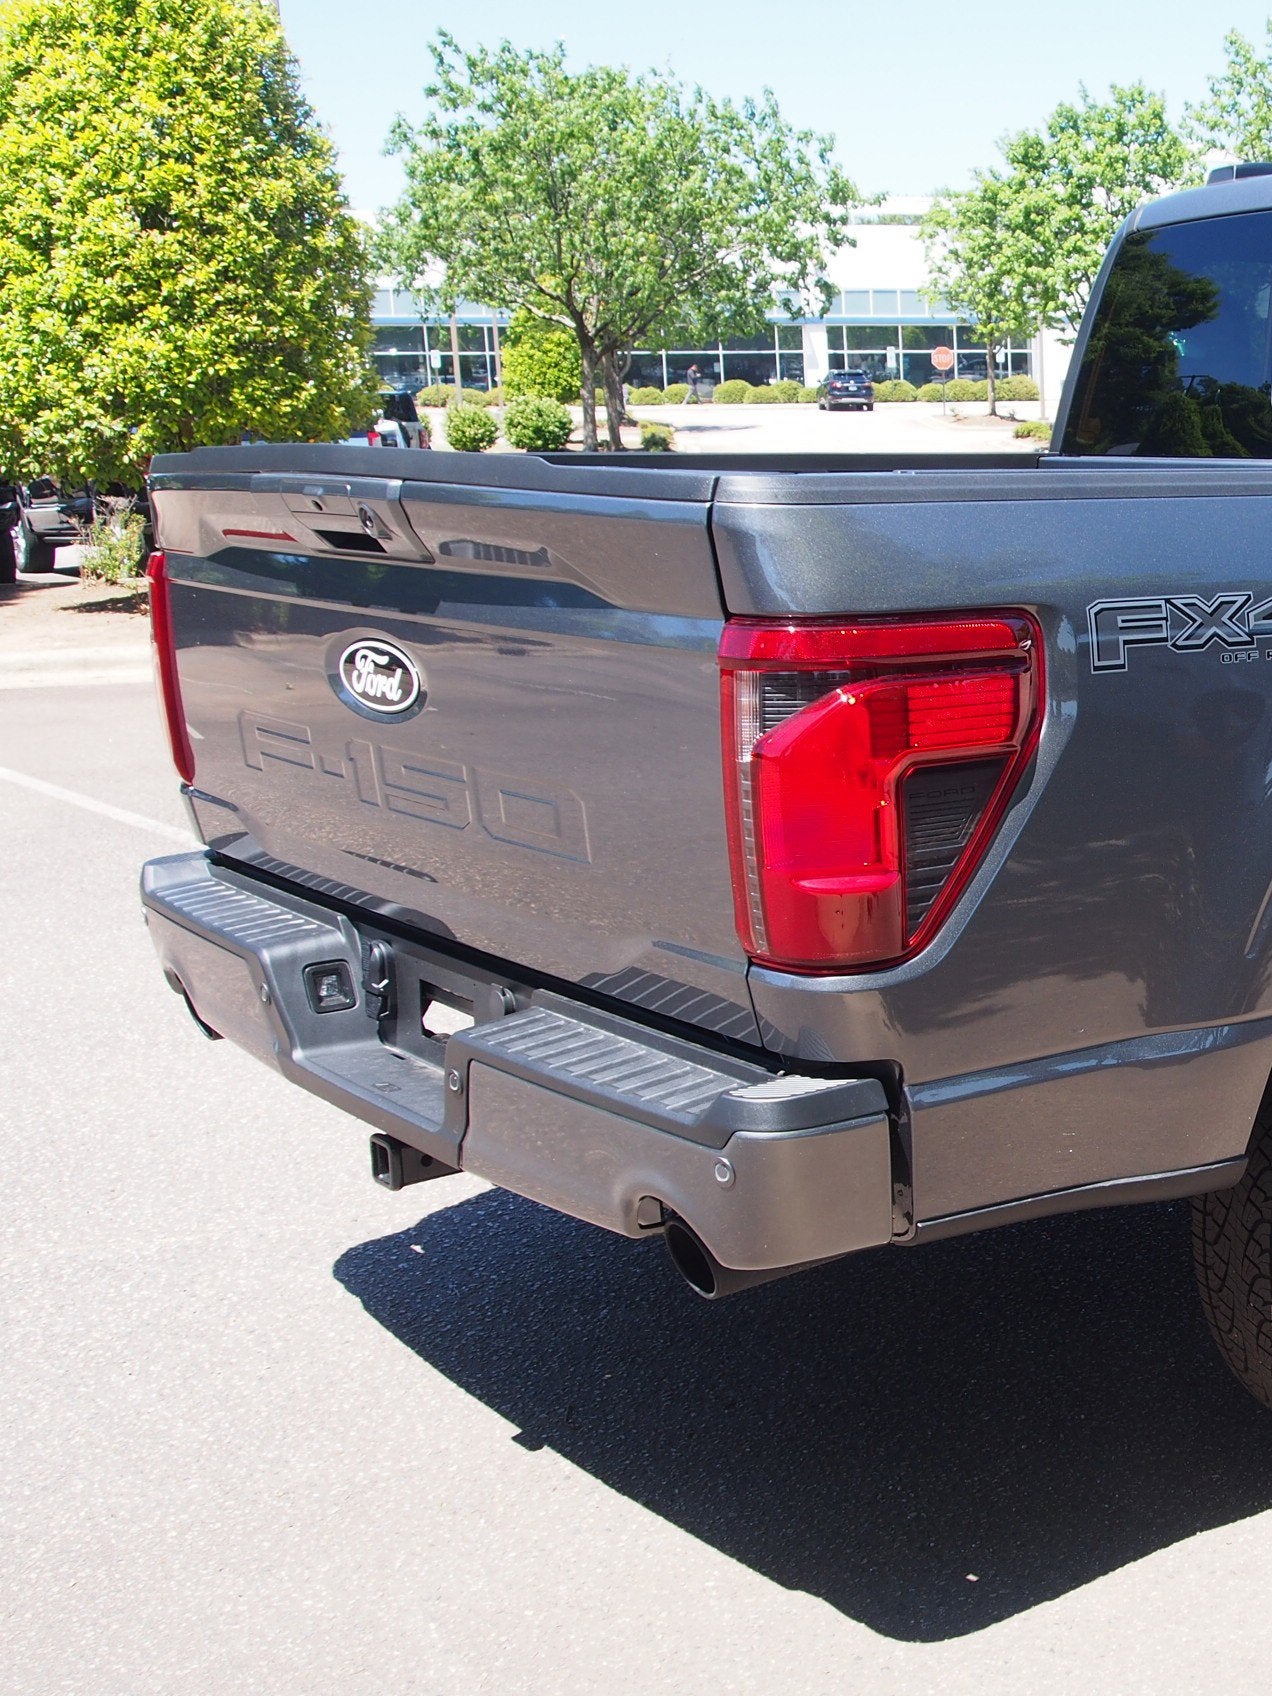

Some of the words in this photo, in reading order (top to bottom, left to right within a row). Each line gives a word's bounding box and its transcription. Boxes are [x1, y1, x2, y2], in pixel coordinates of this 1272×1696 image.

[933, 353, 952, 363] STOP
[1221, 651, 1260, 664] OFF
[351, 647, 404, 702] Ford
[237, 709, 593, 865] F-150
[908, 786, 976, 800] FORD
